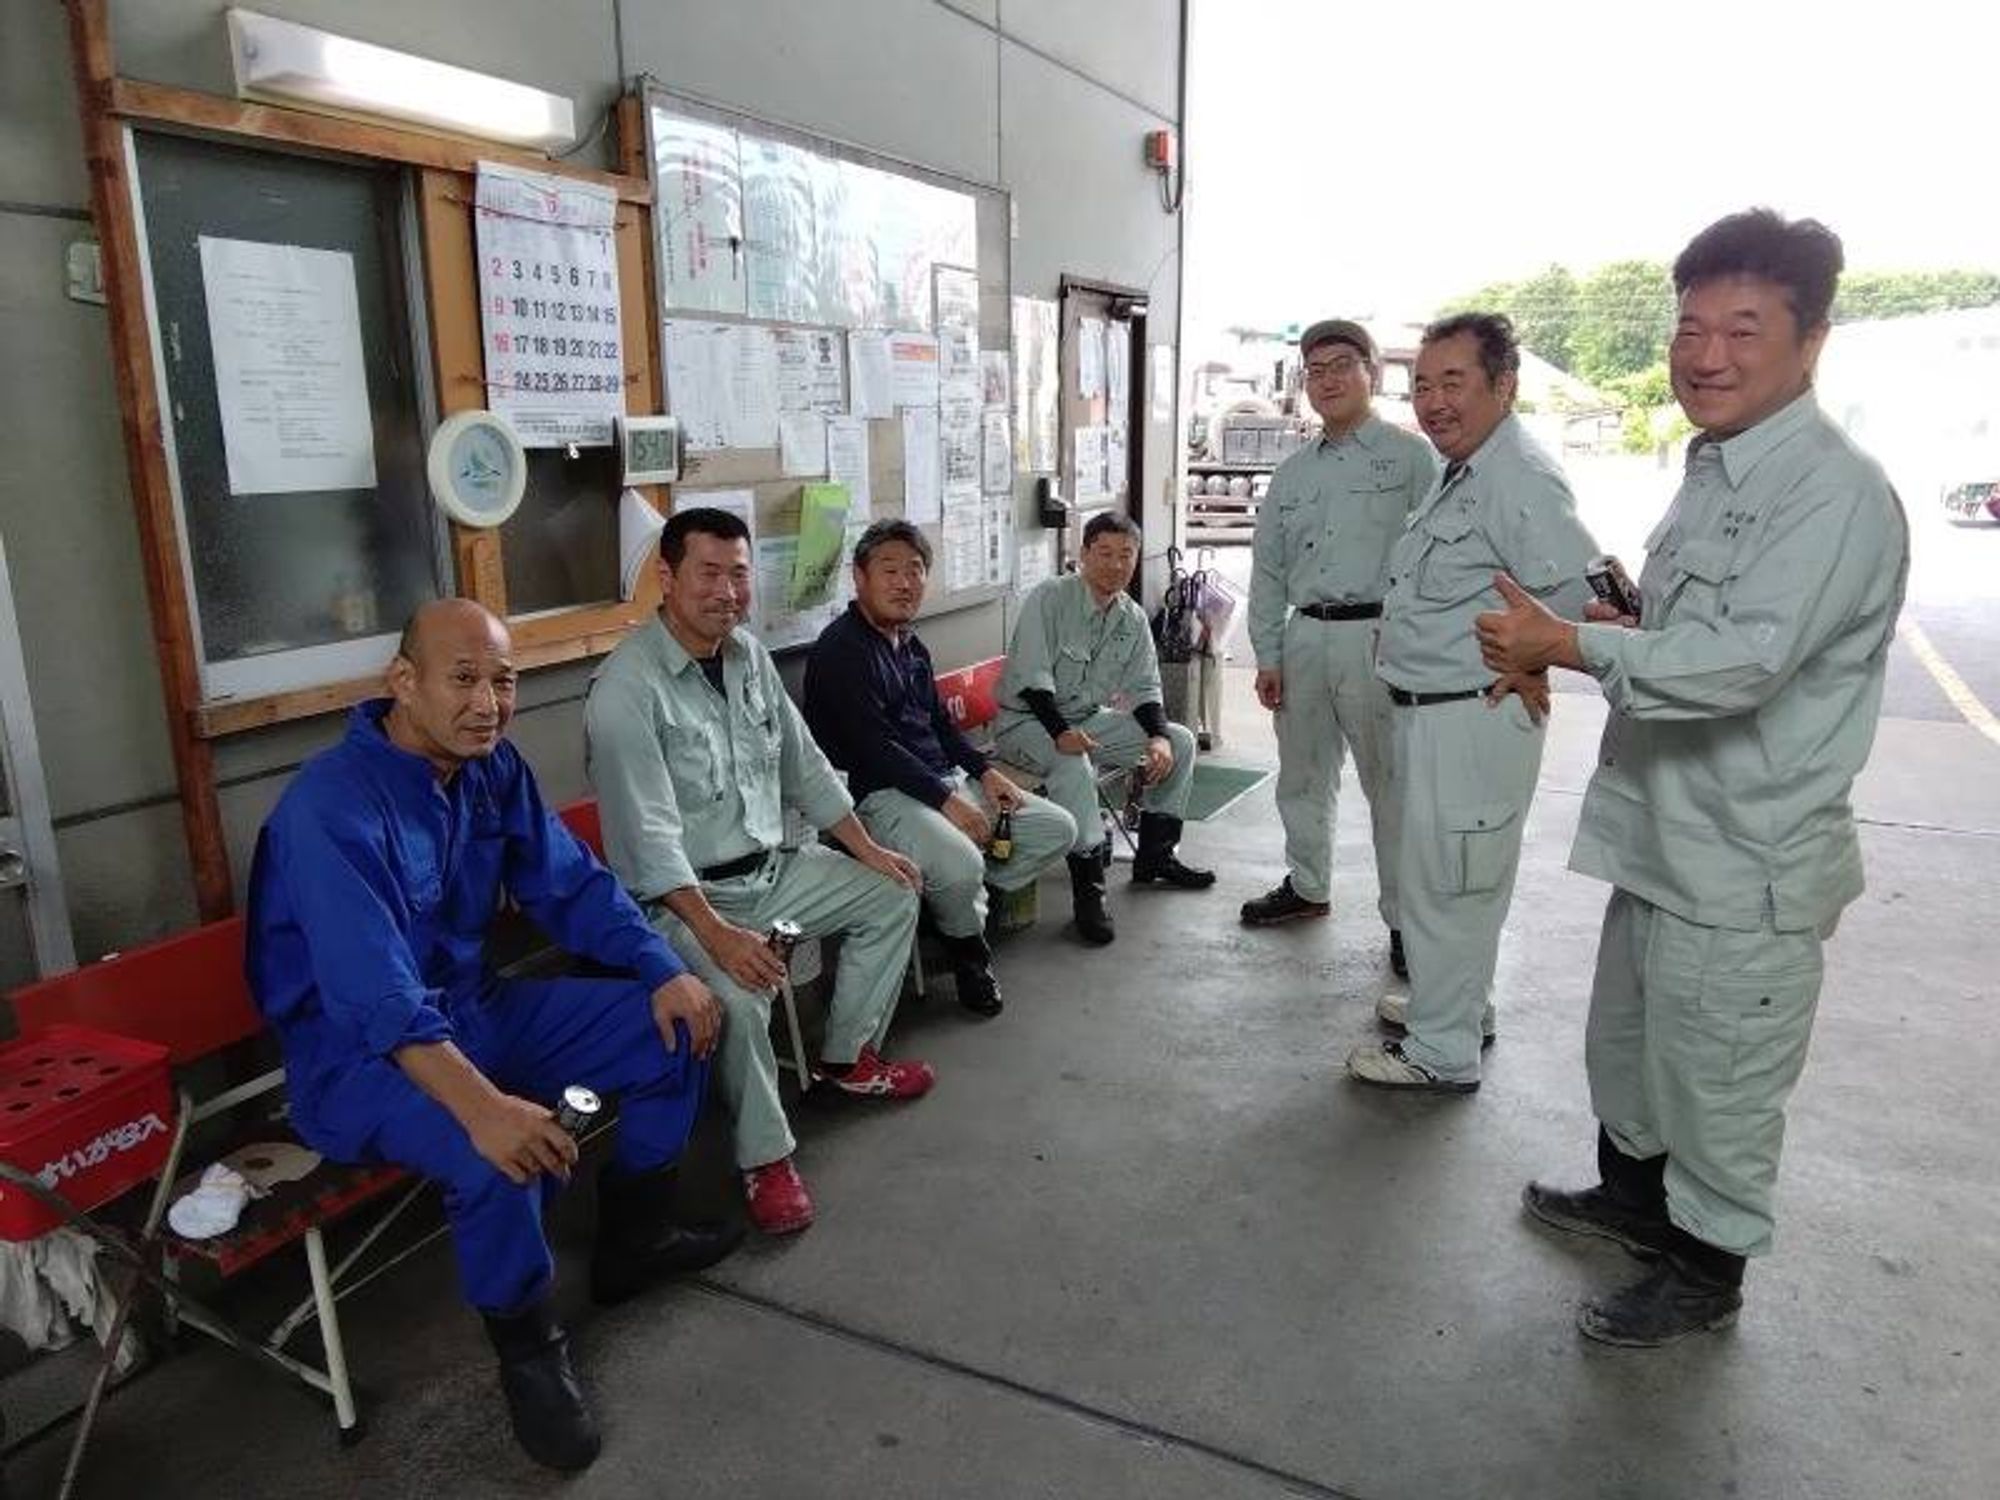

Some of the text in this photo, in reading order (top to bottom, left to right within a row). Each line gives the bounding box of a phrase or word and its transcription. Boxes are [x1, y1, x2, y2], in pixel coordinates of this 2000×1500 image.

[600, 238, 607, 255] 1
[491, 257, 502, 276] 2
[511, 259, 524, 280] 3
[532, 263, 543, 281] 4
[550, 264, 561, 284] 5
[569, 266, 580, 287] 6
[586, 269, 597, 288] 7
[511, 297, 529, 319] 10
[532, 300, 547, 319] 11
[551, 301, 567, 321] 12
[569, 303, 584, 322] 13
[587, 304, 600, 323] 14
[602, 306, 617, 324] 15
[513, 334, 529, 355] 17
[533, 336, 549, 357] 18
[552, 336, 567, 357] 19
[569, 338, 585, 358] 20
[586, 339, 602, 359] 21
[603, 340, 618, 359] 22
[513, 370, 531, 391] 24
[534, 372, 549, 392] 25
[552, 372, 569, 392] 26
[571, 373, 585, 391] 27
[588, 374, 602, 391] 28
